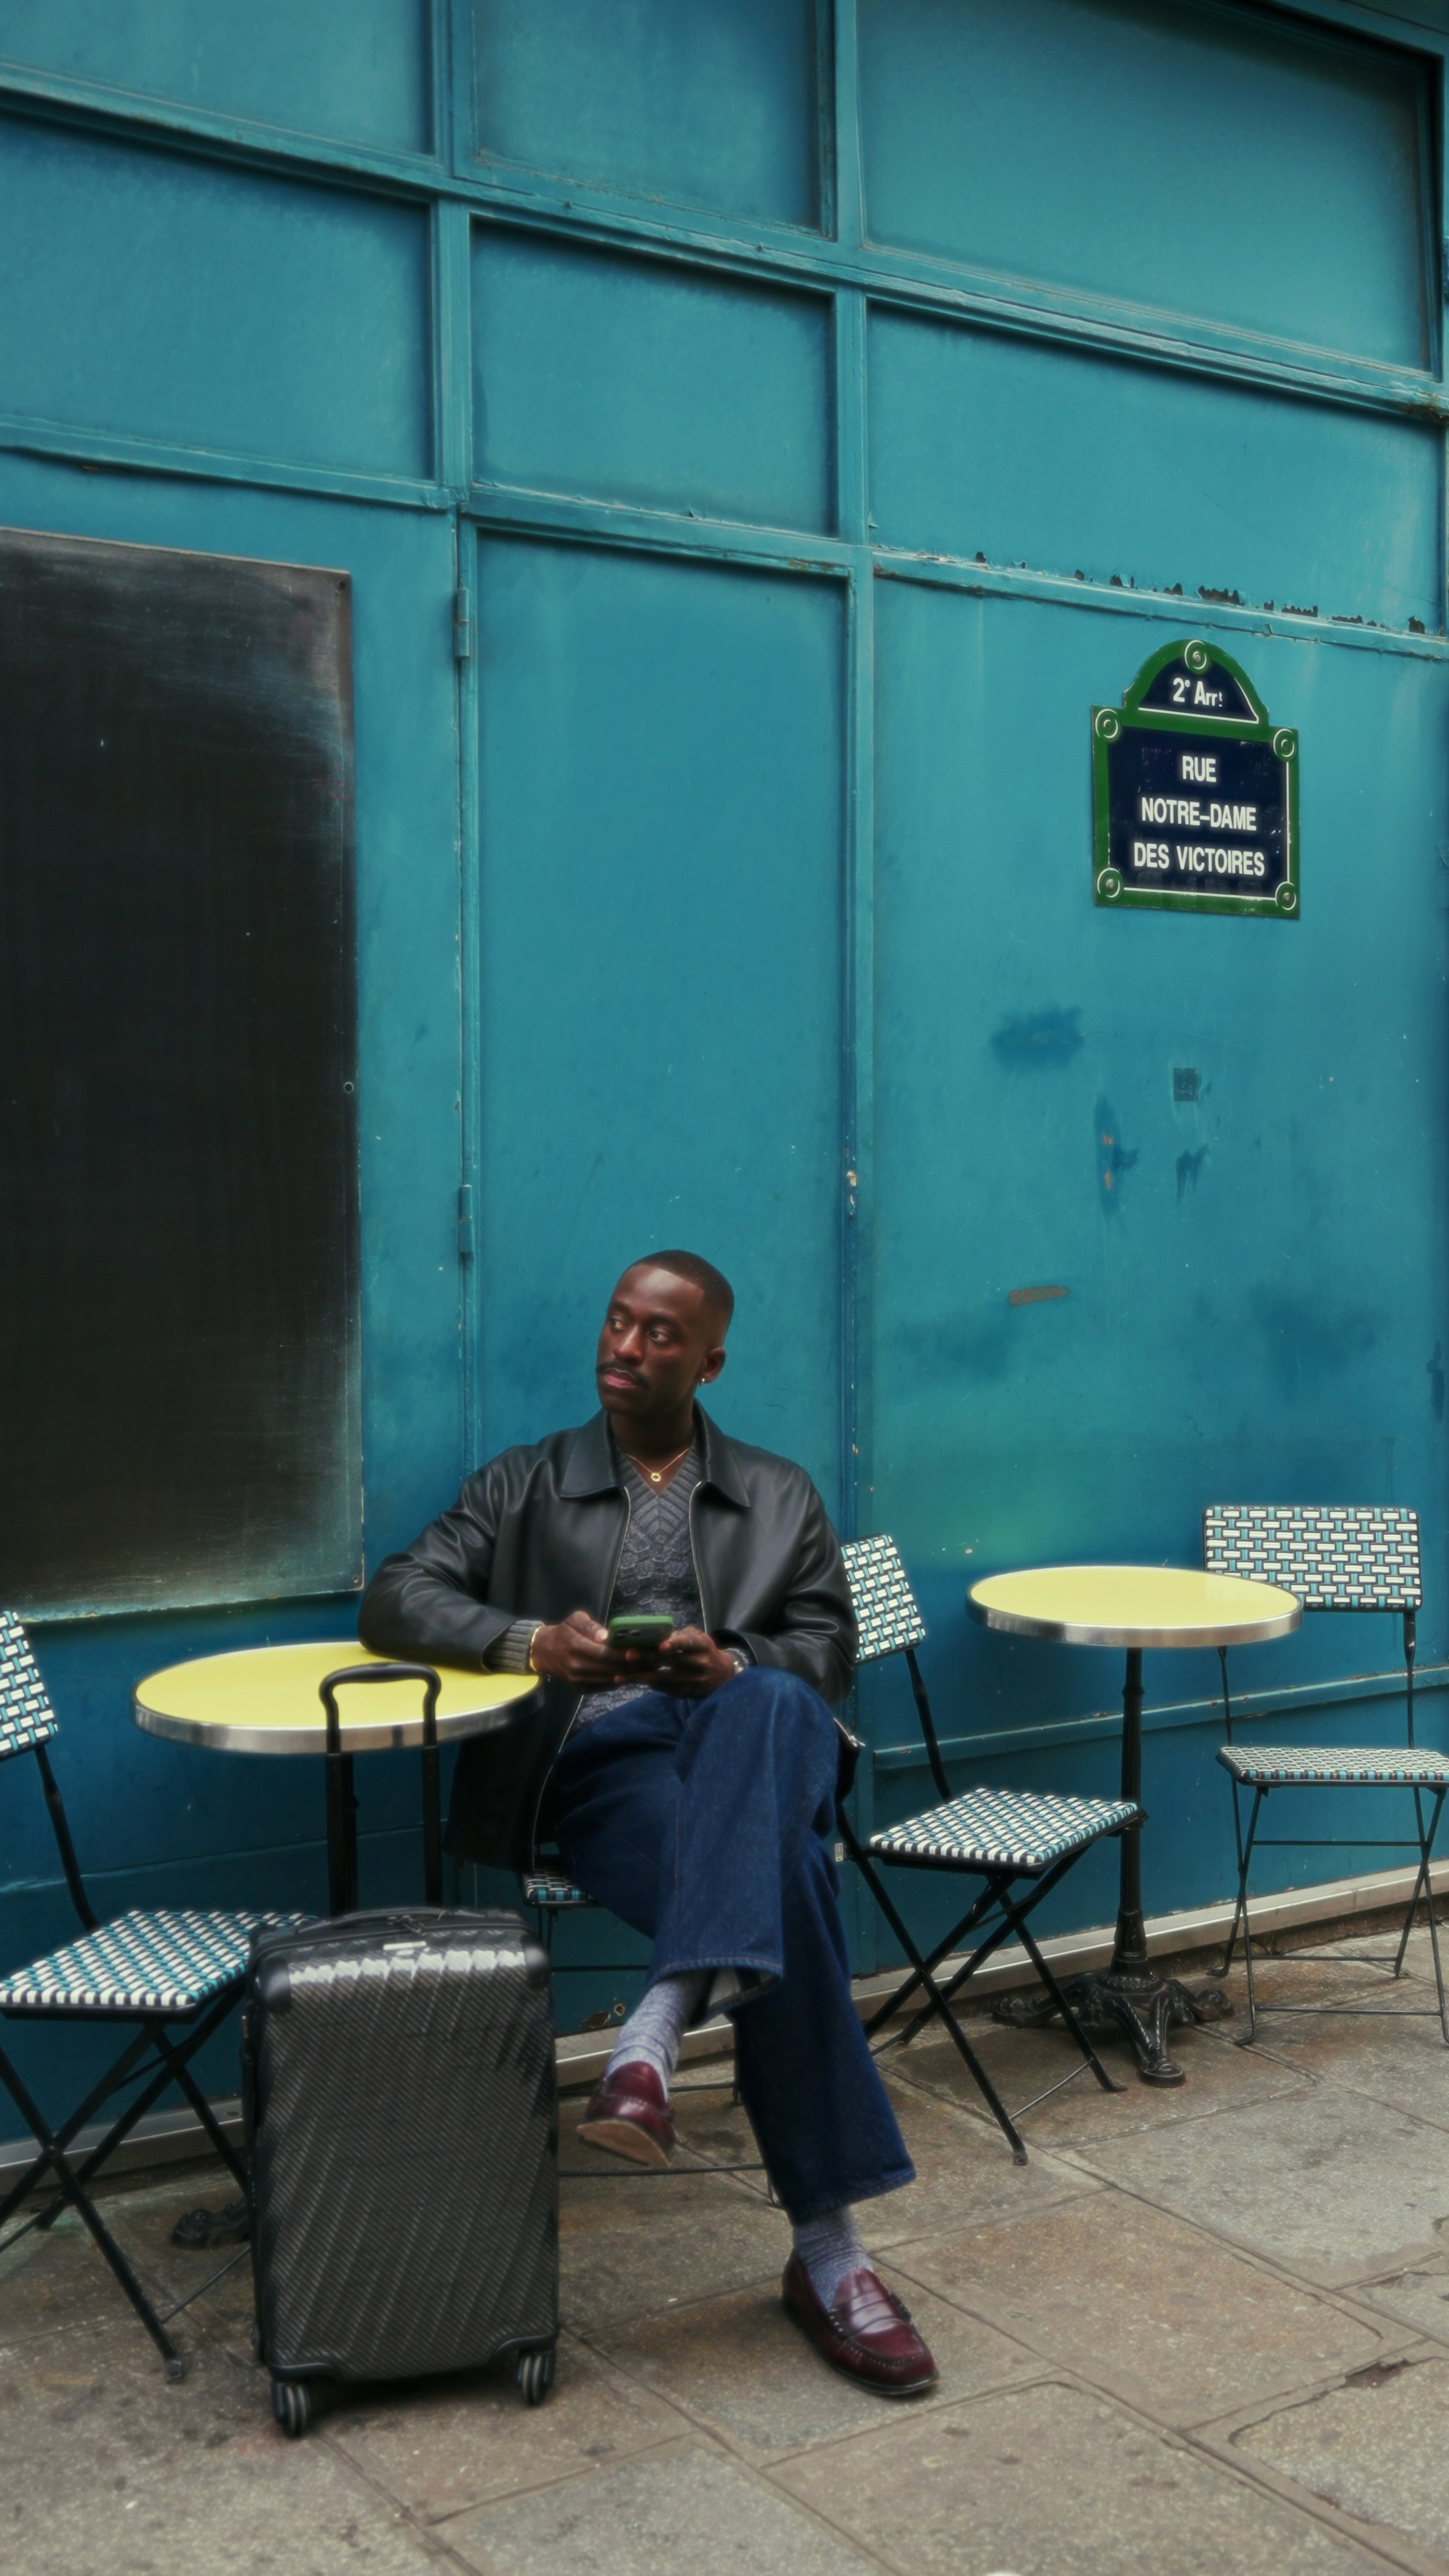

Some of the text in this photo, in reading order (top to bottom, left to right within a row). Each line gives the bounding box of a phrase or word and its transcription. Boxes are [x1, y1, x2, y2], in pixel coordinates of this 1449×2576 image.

[1182, 755, 1217, 783] RUE
[1141, 796, 1256, 831] NOTRE-DAME
[1134, 842, 1265, 876] DES VICTOIRES
